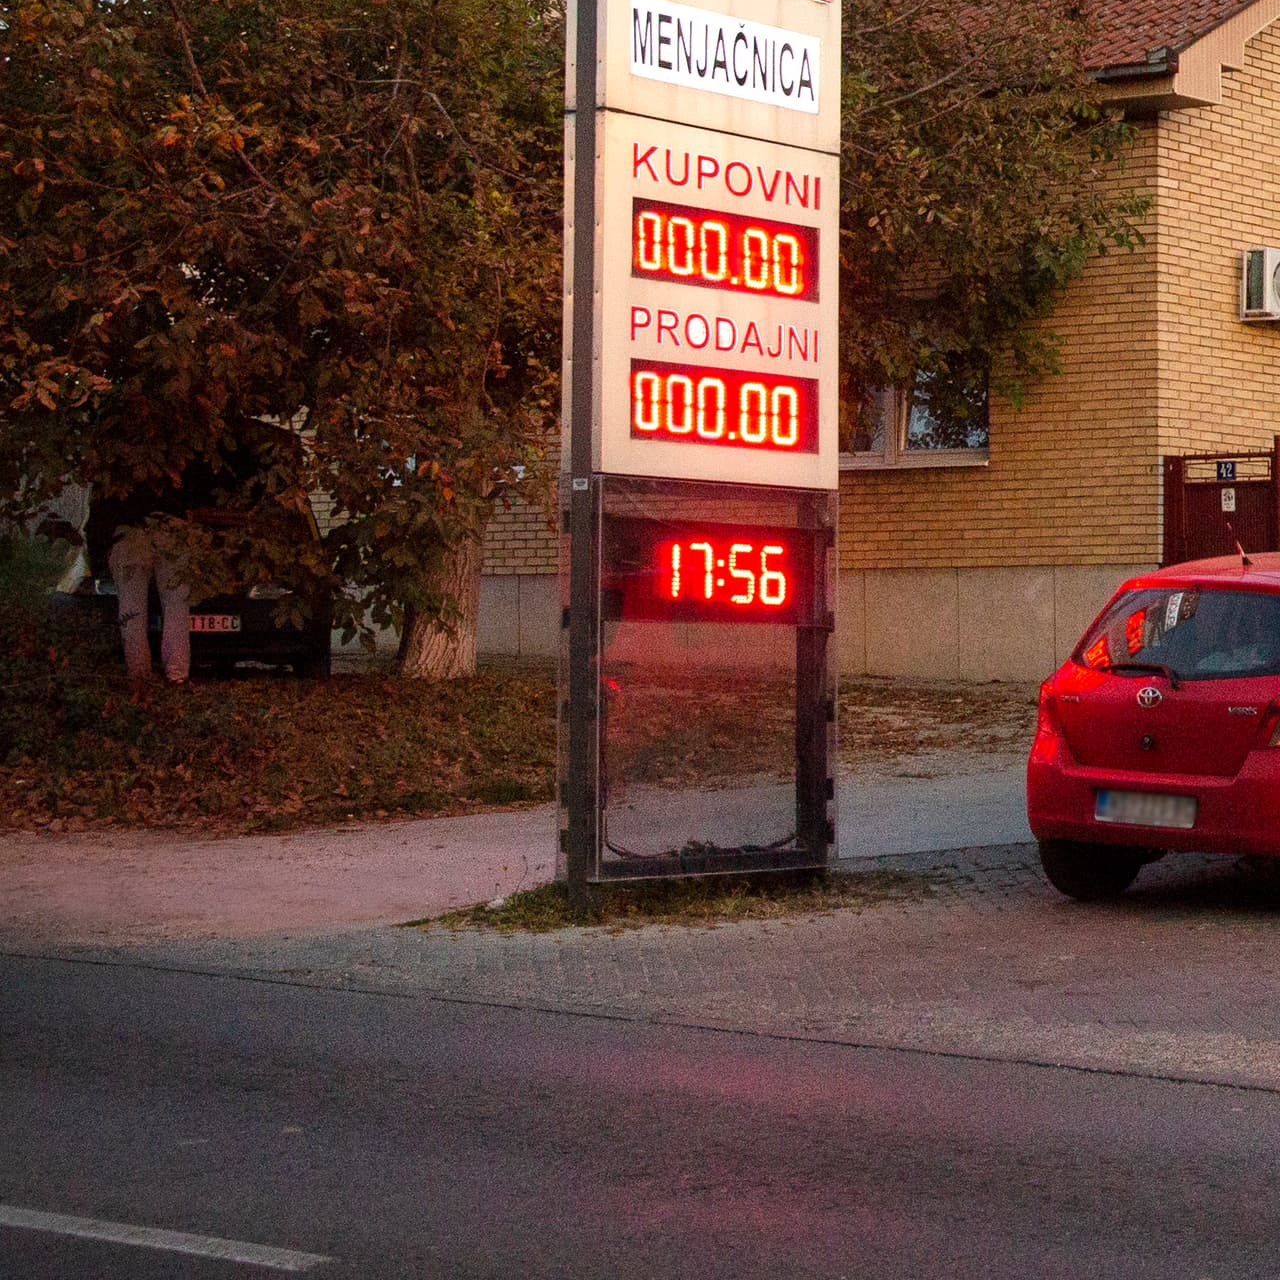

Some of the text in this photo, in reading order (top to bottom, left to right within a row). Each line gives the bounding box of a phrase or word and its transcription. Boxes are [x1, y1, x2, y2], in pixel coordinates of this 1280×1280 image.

[633, 7, 815, 102] MENJAČNICA
[632, 142, 822, 210] KUPOVNI
[637, 211, 799, 295] 000.00
[630, 305, 820, 363] PRODAJNI
[634, 371, 798, 446] 000.00
[1220, 463, 1233, 478] 42
[671, 541, 787, 606] 17:56
